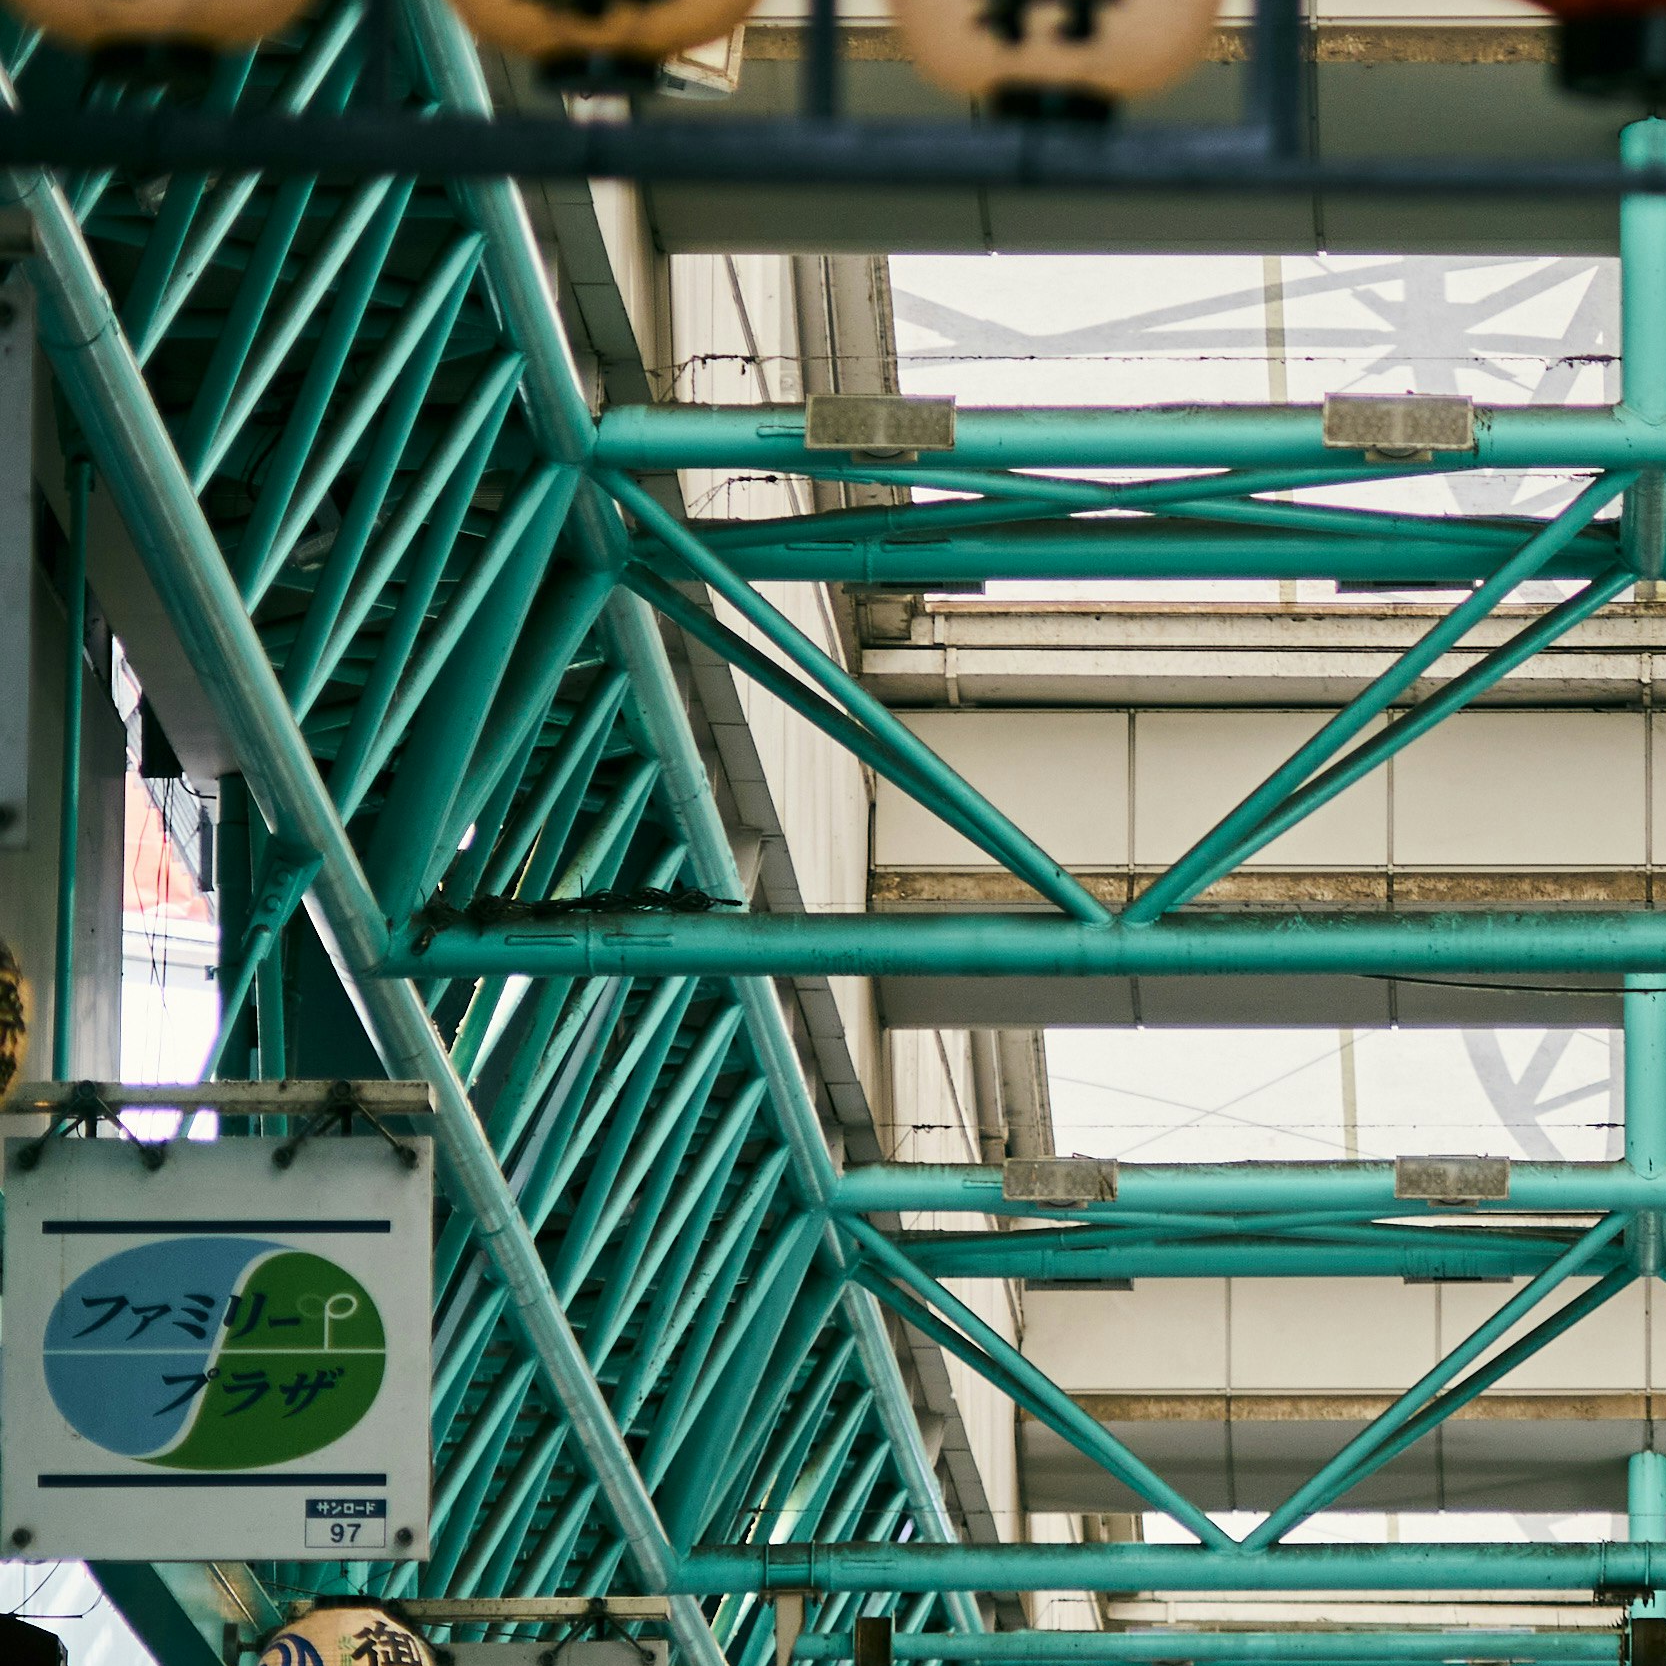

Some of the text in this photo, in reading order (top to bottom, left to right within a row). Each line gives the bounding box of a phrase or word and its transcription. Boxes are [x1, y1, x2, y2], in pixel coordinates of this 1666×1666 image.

[72, 1293, 302, 1341] ファミリー
[154, 1367, 345, 1419] プラザ
[316, 1500, 378, 1515] サンロード
[328, 1522, 362, 1544] 97
